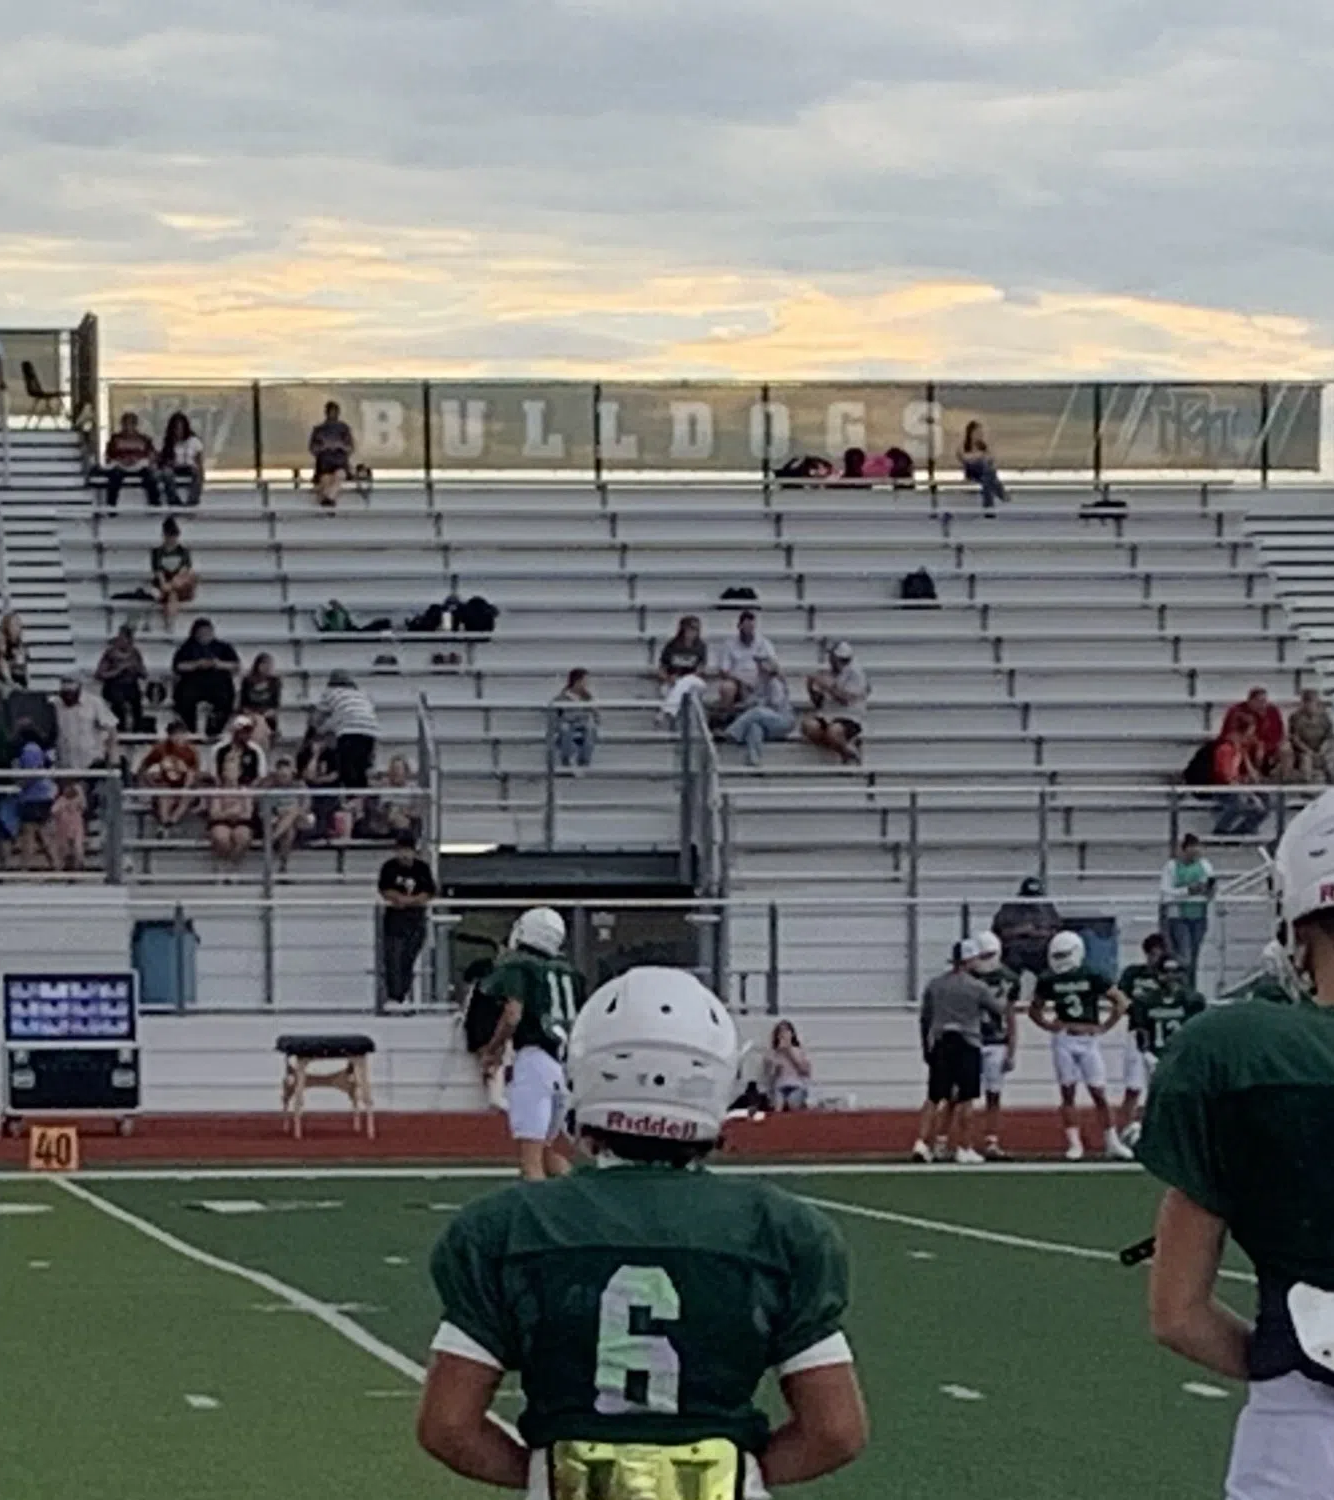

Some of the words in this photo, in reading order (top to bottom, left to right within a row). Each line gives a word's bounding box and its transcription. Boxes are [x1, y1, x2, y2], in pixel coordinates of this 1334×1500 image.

[359, 398, 943, 462] BULLDOGS
[35, 1131, 72, 1167] 40
[607, 1111, 697, 1140] Riddell
[594, 1264, 681, 1415] 6
